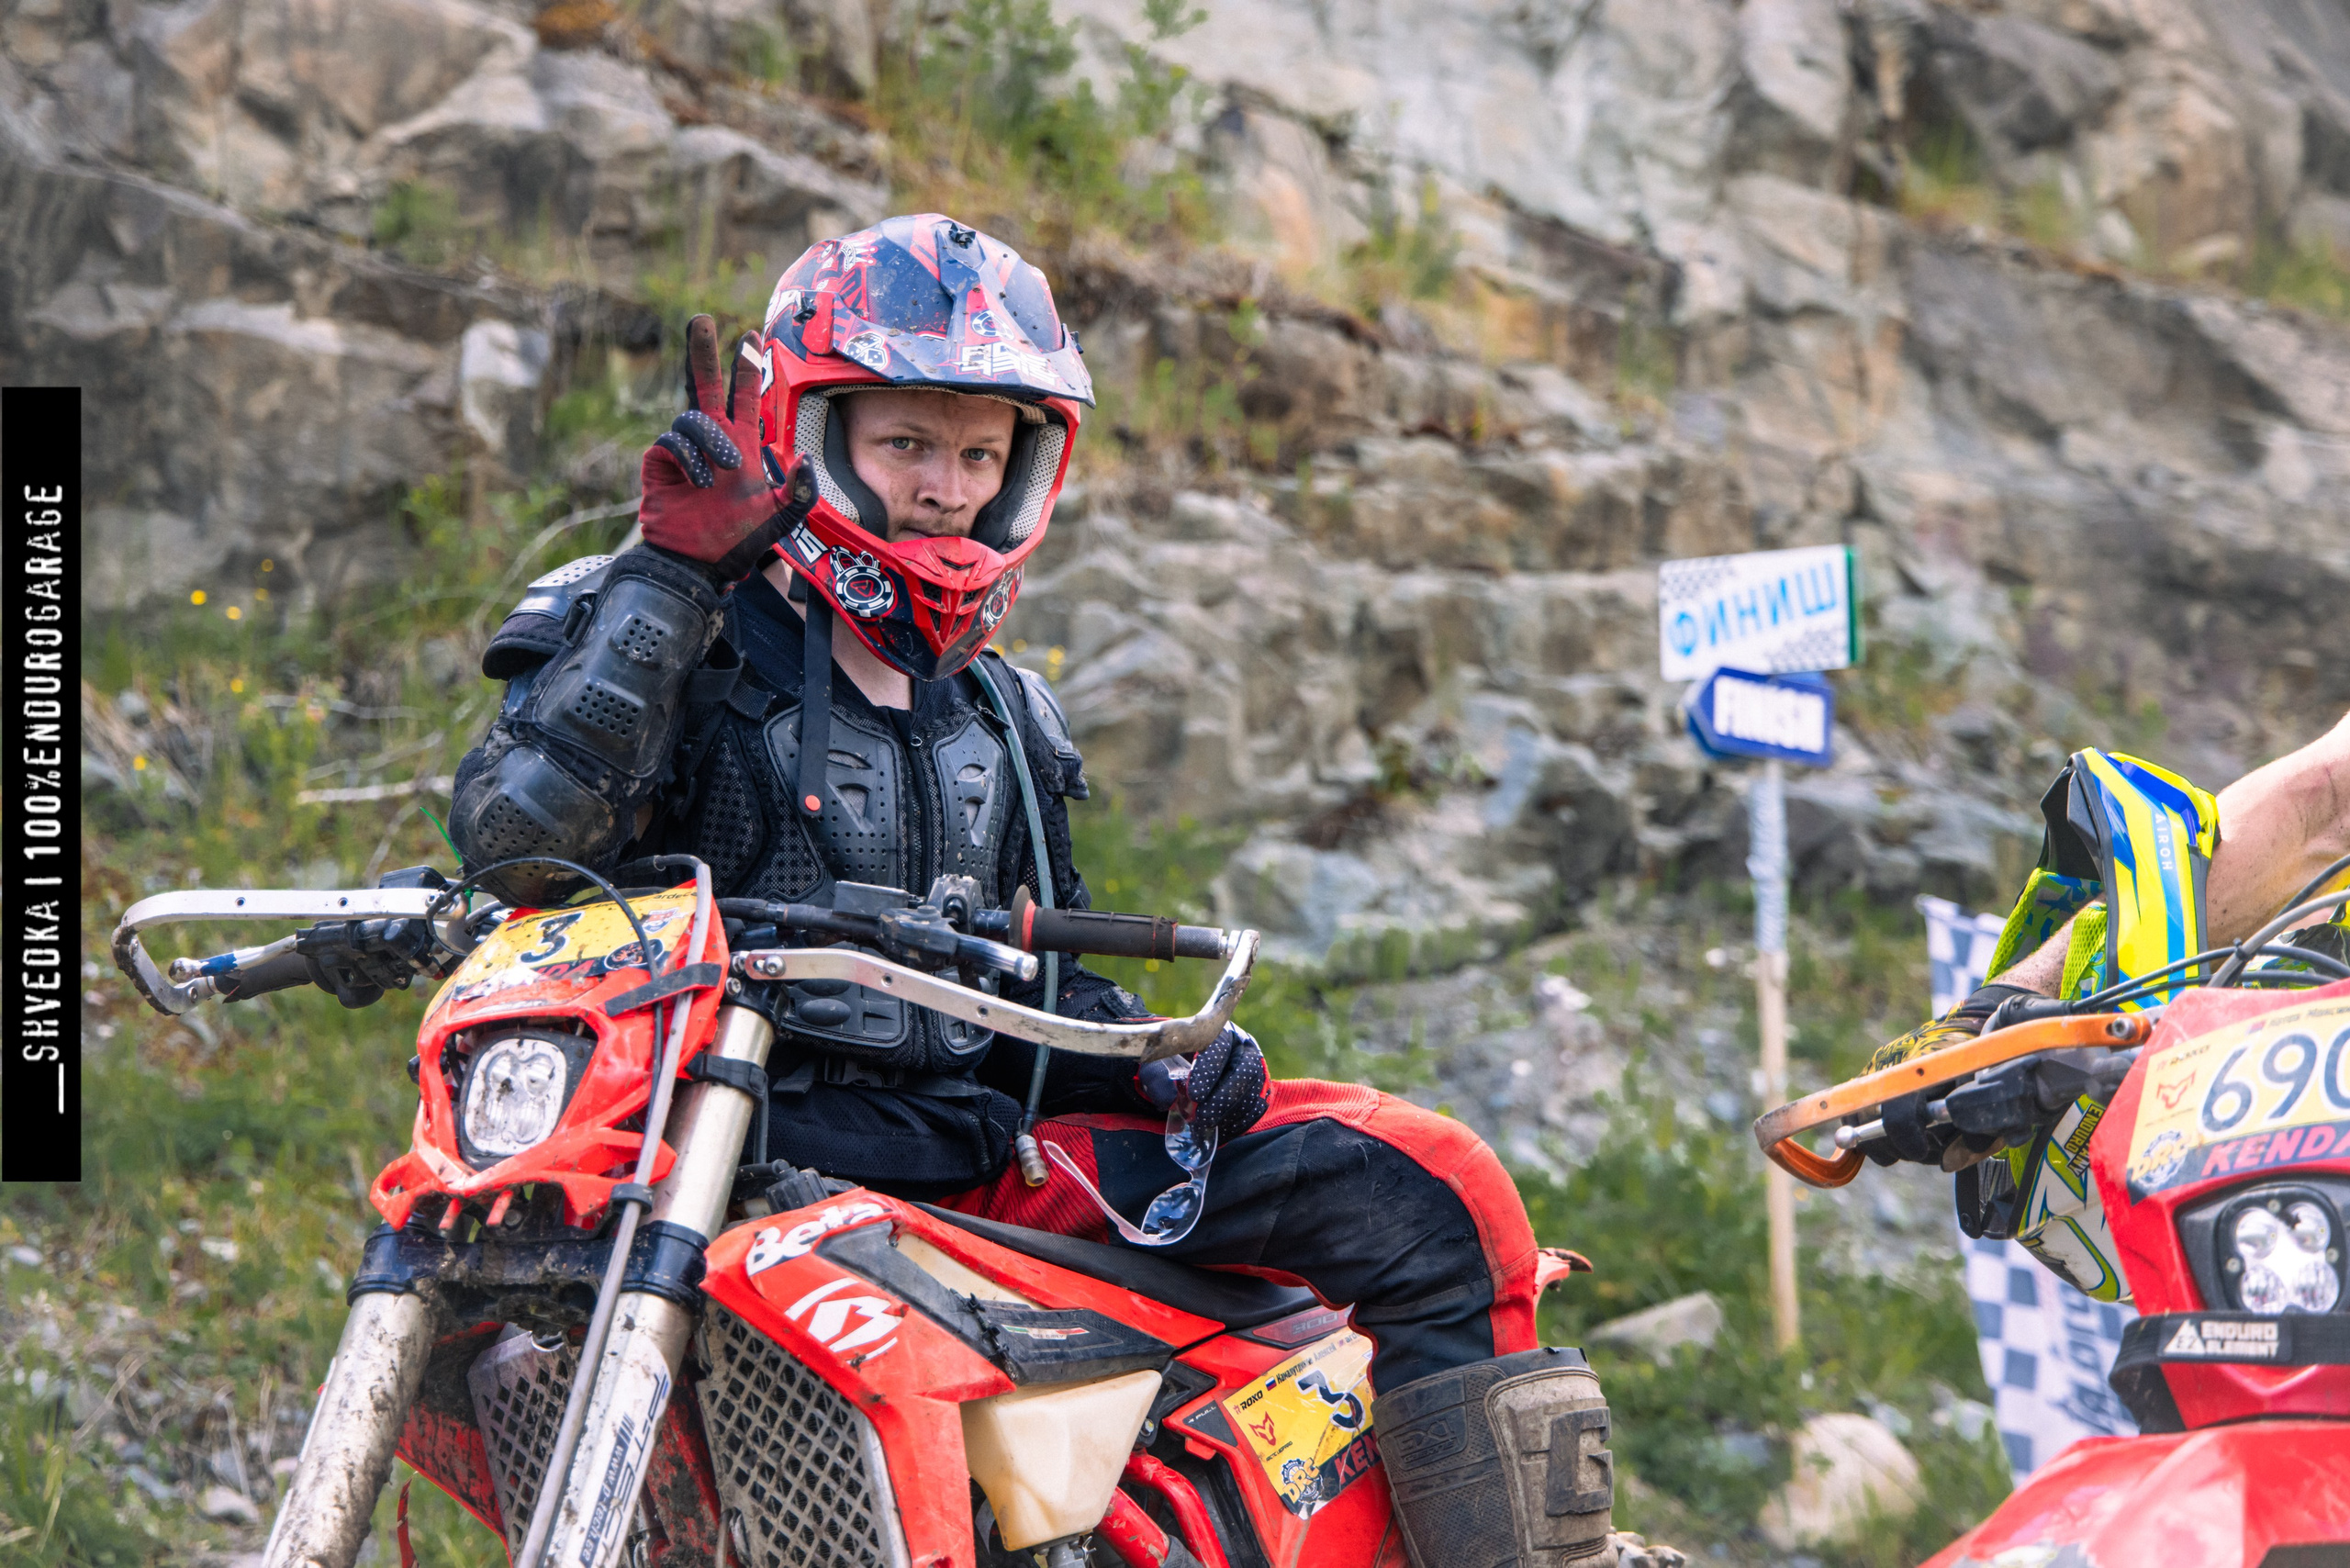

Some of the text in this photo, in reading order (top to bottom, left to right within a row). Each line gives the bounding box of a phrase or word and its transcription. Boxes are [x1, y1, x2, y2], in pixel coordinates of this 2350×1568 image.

[1667, 562, 1836, 657] ФИНИШ
[2154, 813, 2173, 871] AIROH
[517, 910, 585, 965] 3
[2065, 1105, 2104, 1154] ENDURO
[745, 1204, 885, 1277] Beta
[1292, 1311, 1338, 1335] 300
[2201, 1321, 2278, 1340] ENDURO
[1195, 1406, 1216, 1420] PULL
[1239, 1390, 1264, 1410] ROXO
[1296, 1369, 1365, 1431] 3
[1281, 1457, 1320, 1504] DRC
[1334, 1429, 1381, 1485] KEN
